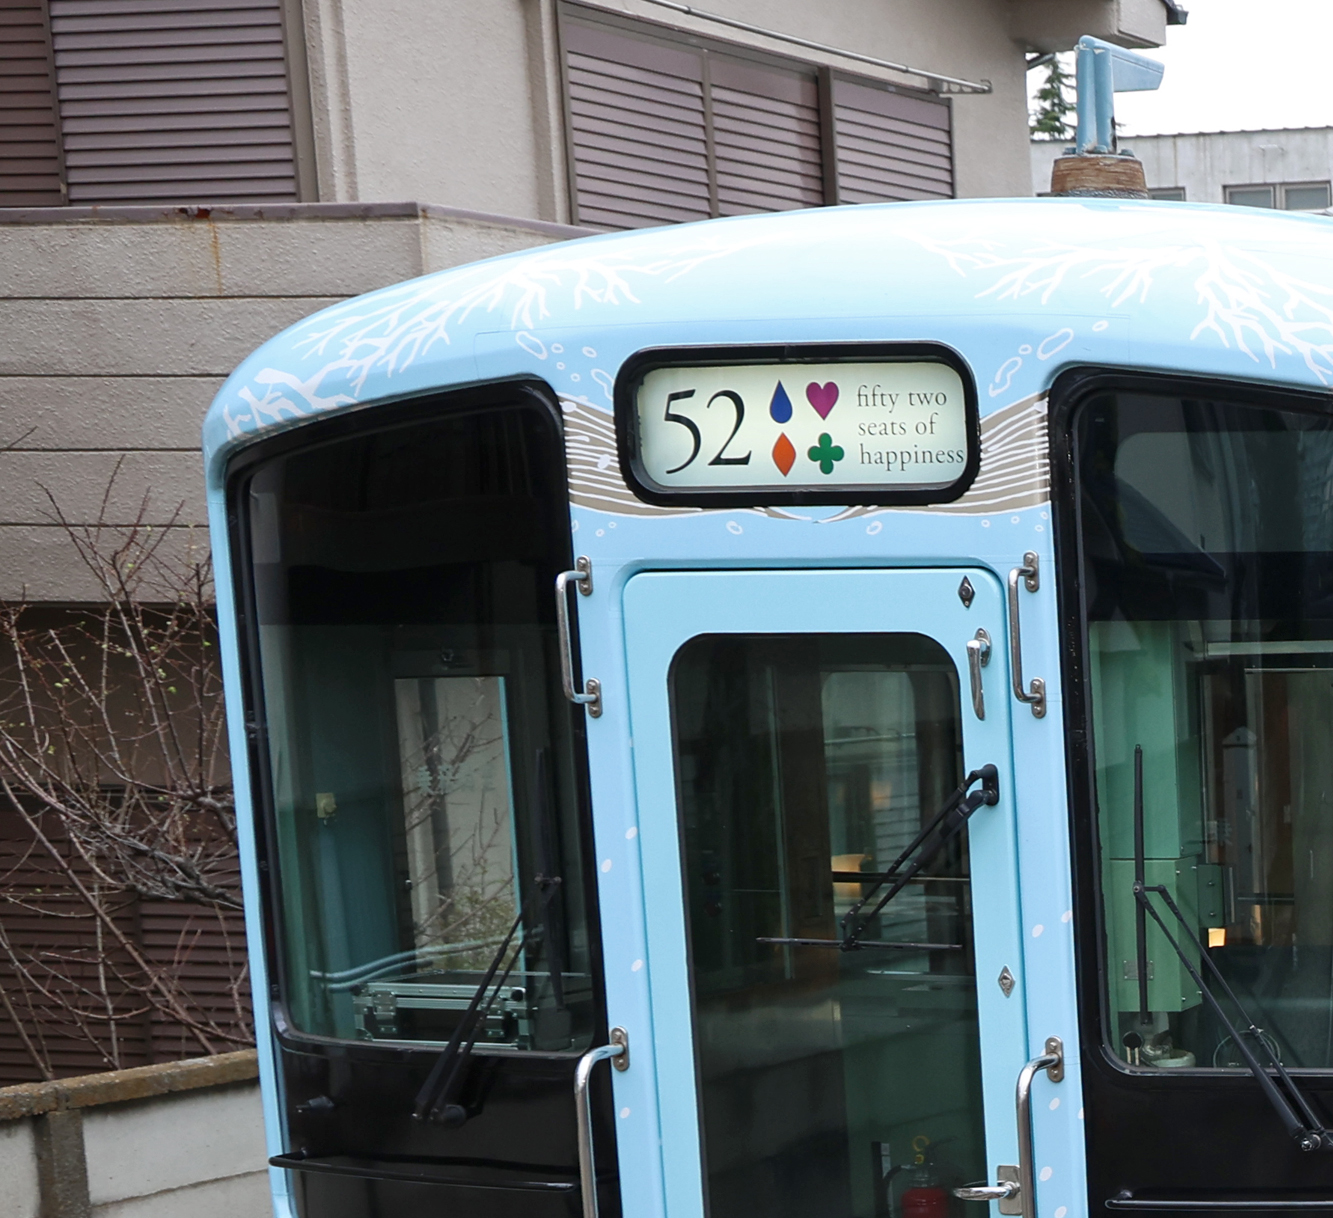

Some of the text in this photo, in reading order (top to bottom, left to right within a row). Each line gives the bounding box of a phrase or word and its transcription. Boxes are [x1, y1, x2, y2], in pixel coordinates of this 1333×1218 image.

[857, 384, 947, 414] fifty two
[663, 388, 752, 475] 52
[858, 412, 939, 436] seats of
[860, 443, 965, 472] happiness
